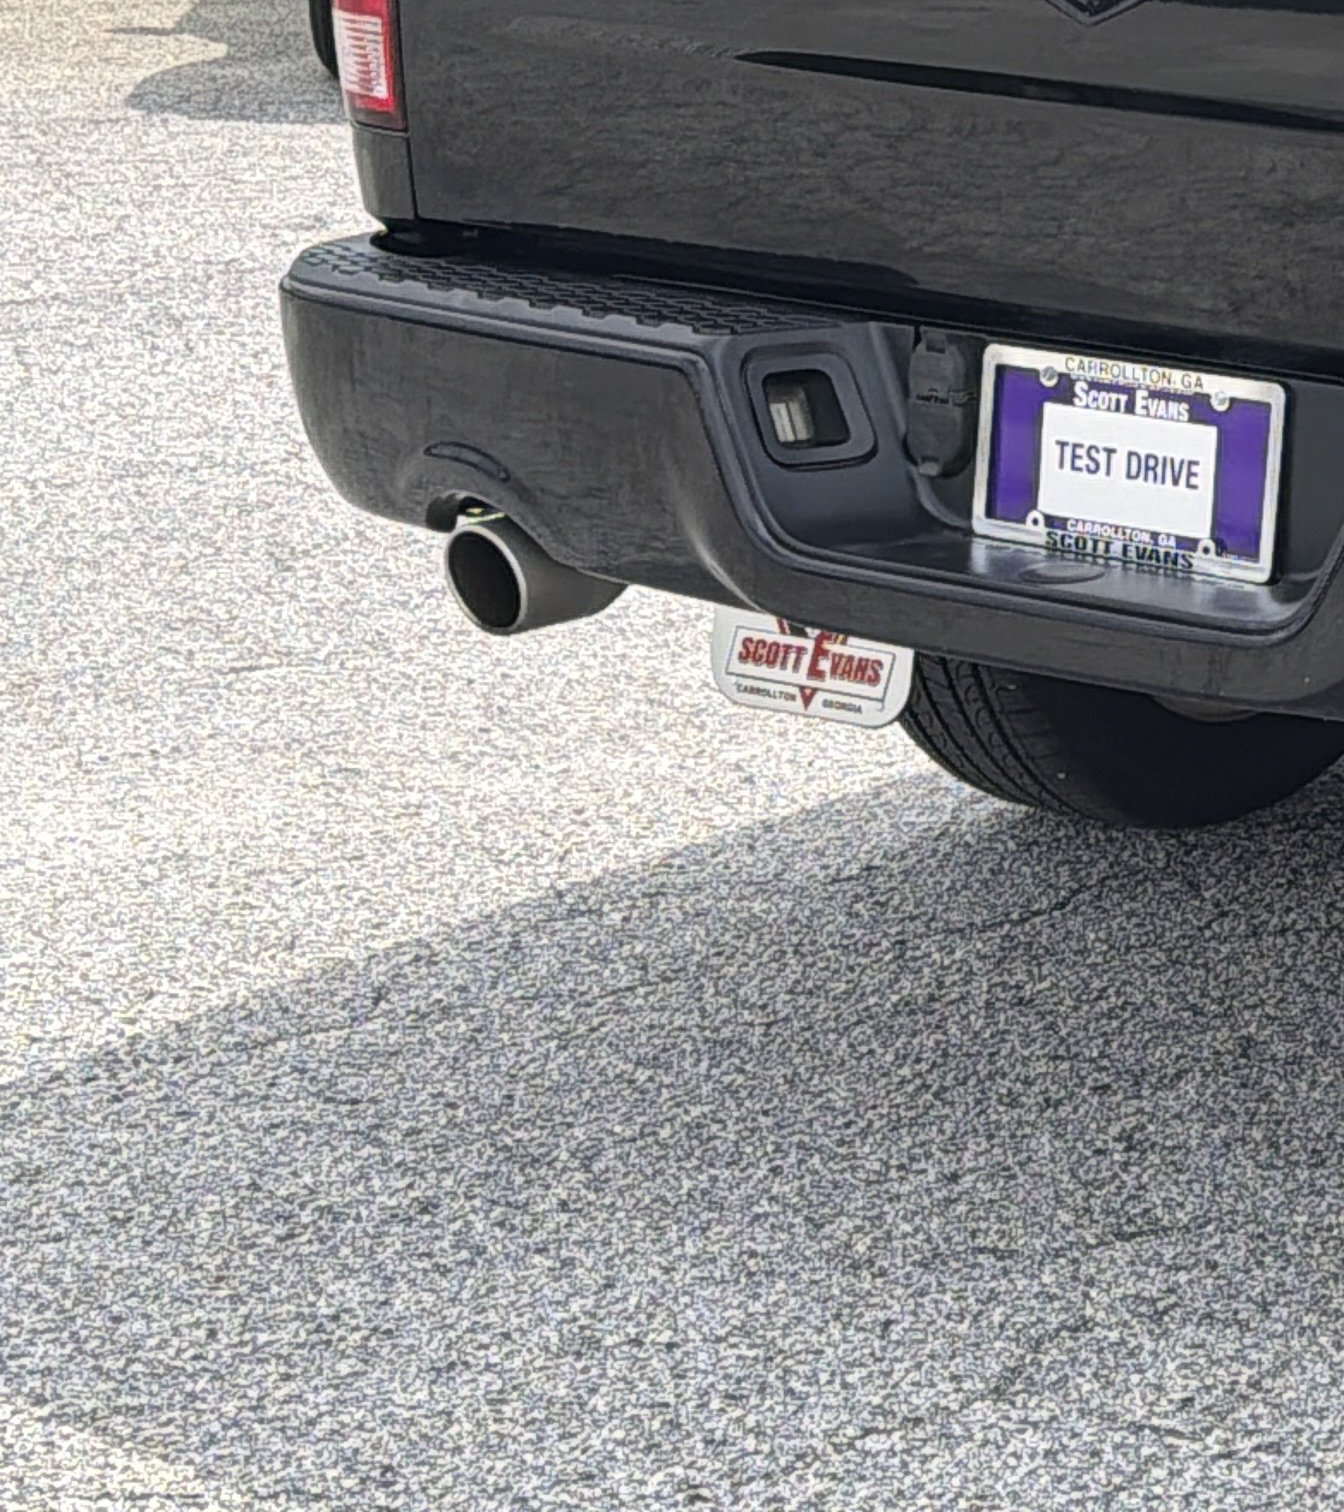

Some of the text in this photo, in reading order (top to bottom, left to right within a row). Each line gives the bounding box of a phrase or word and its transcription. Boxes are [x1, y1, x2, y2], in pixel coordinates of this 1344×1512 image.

[1073, 380, 1190, 422] SCOTT EVANS
[1180, 373, 1204, 391] GA
[1055, 440, 1201, 491] TEST DRIVE
[1045, 531, 1195, 570] SCOTT EVANS
[738, 631, 884, 687] SCOTT EVANS
